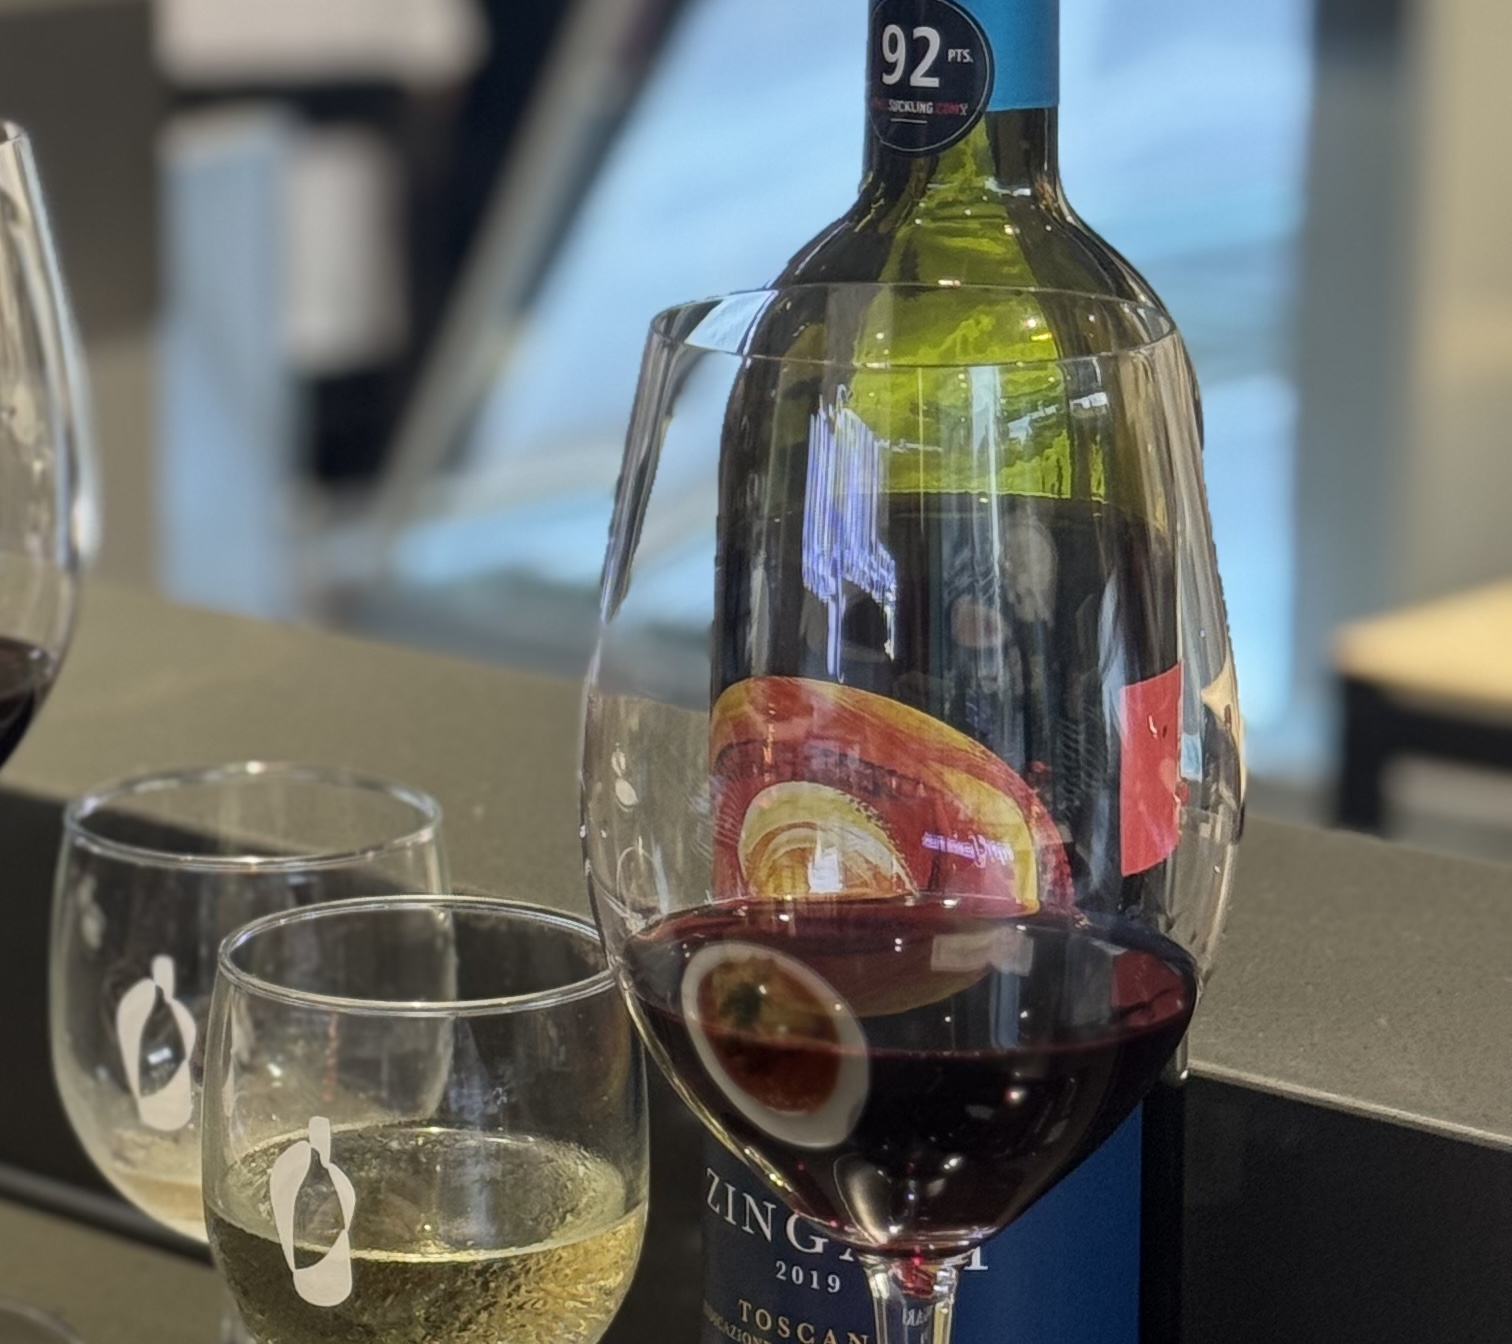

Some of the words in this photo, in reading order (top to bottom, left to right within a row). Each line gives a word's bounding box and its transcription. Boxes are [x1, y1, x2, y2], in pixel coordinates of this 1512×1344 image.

[881, 23, 942, 89] 92
[946, 47, 974, 64] PTS.
[705, 1167, 989, 1271] ZING
[775, 1260, 842, 1294] 2019
